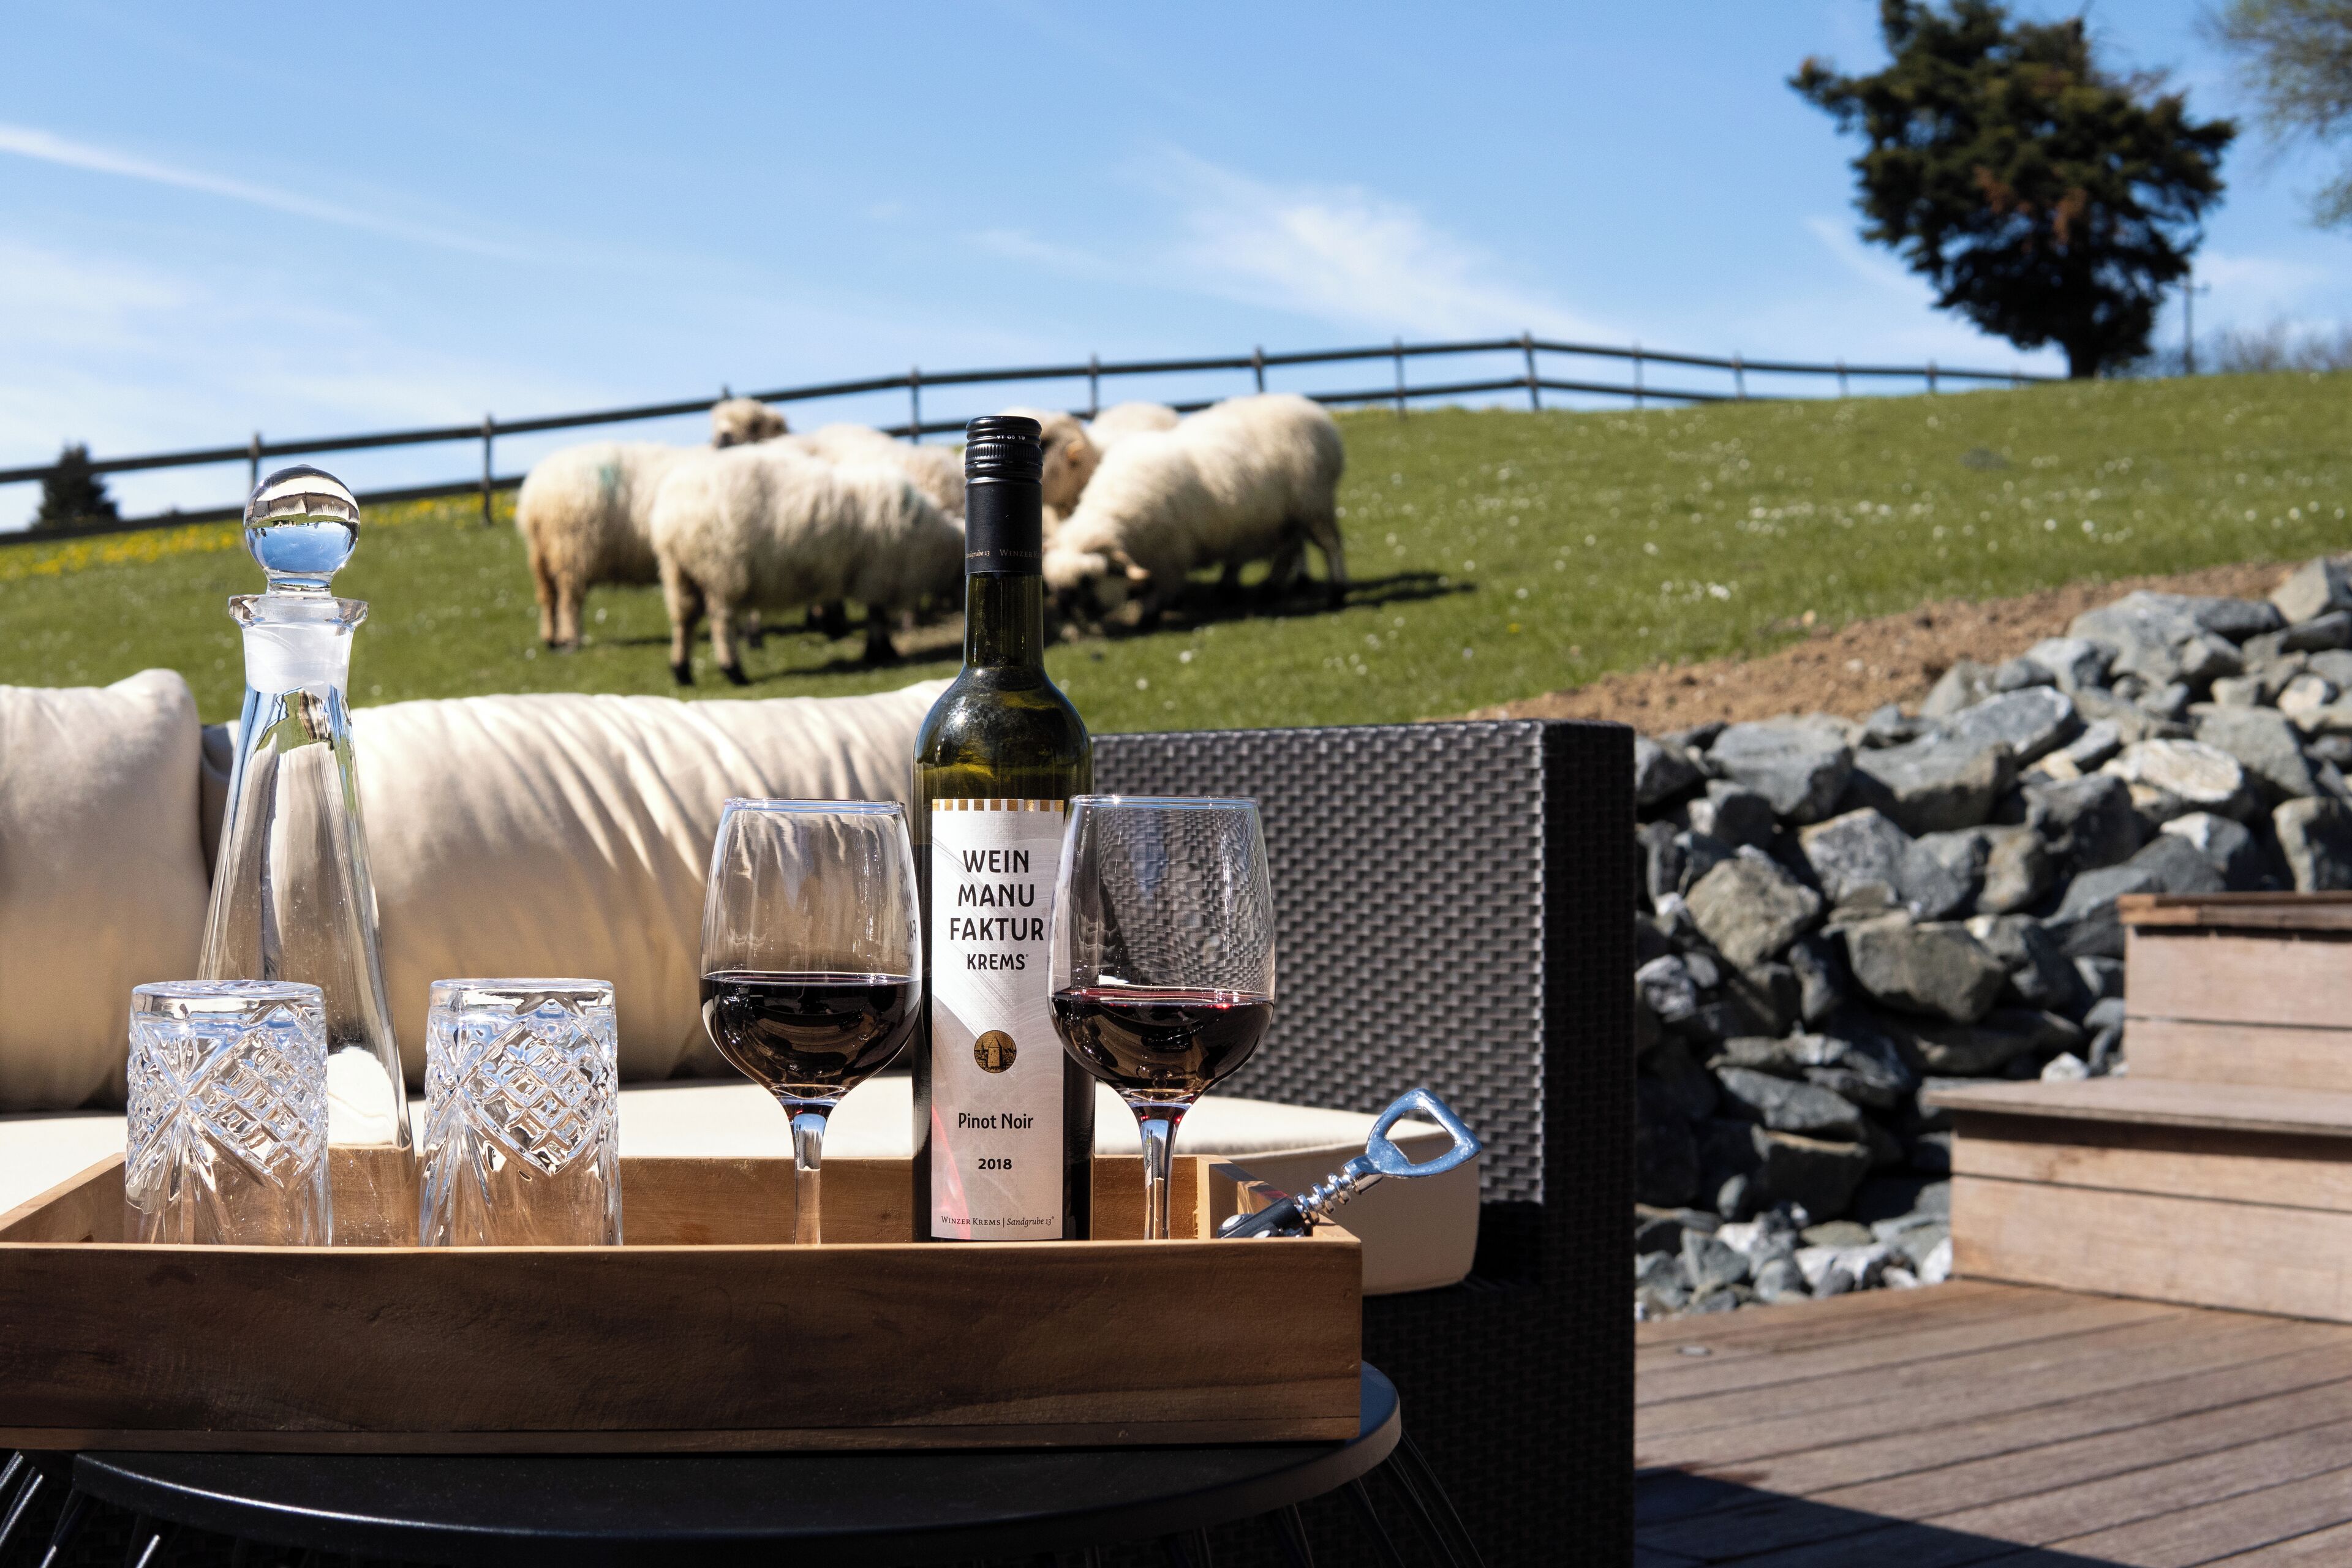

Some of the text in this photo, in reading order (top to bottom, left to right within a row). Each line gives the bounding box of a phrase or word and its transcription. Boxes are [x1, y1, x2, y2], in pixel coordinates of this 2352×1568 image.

[963, 850, 1029, 873] WEIN
[958, 884, 1035, 907] MANU
[951, 918, 1044, 941] FAKTUR
[959, 1112, 1034, 1129] Pinot Noir
[978, 1158, 1012, 1170] 2018
[1006, 1216, 1044, 1228] Sandgrube
